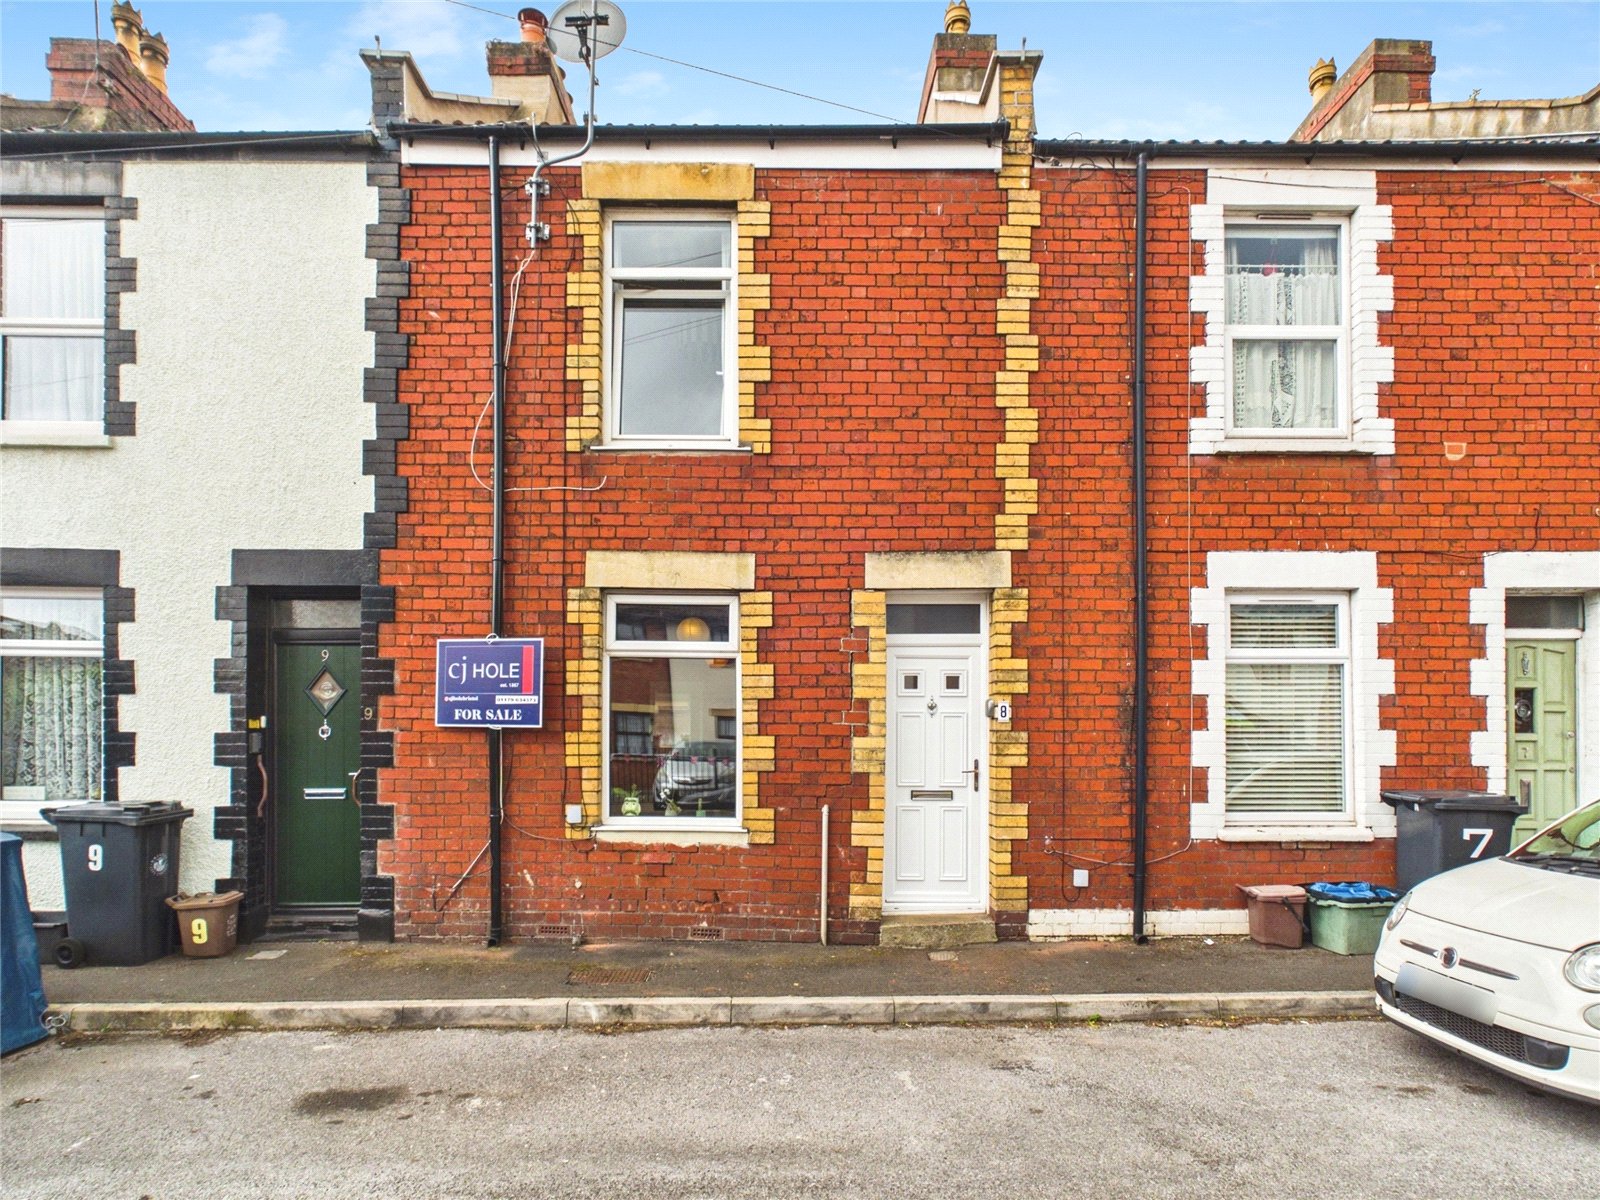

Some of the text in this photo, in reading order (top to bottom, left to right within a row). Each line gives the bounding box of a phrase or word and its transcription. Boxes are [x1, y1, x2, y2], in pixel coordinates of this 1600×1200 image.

[321, 649, 330, 662] 9
[472, 663, 520, 679] HOLE
[364, 707, 373, 720] 9
[454, 708, 522, 721] FOR SALE
[1000, 705, 1007, 718] 8
[1463, 828, 1493, 859] 7
[88, 844, 103, 871] 9
[191, 918, 208, 945] 9
